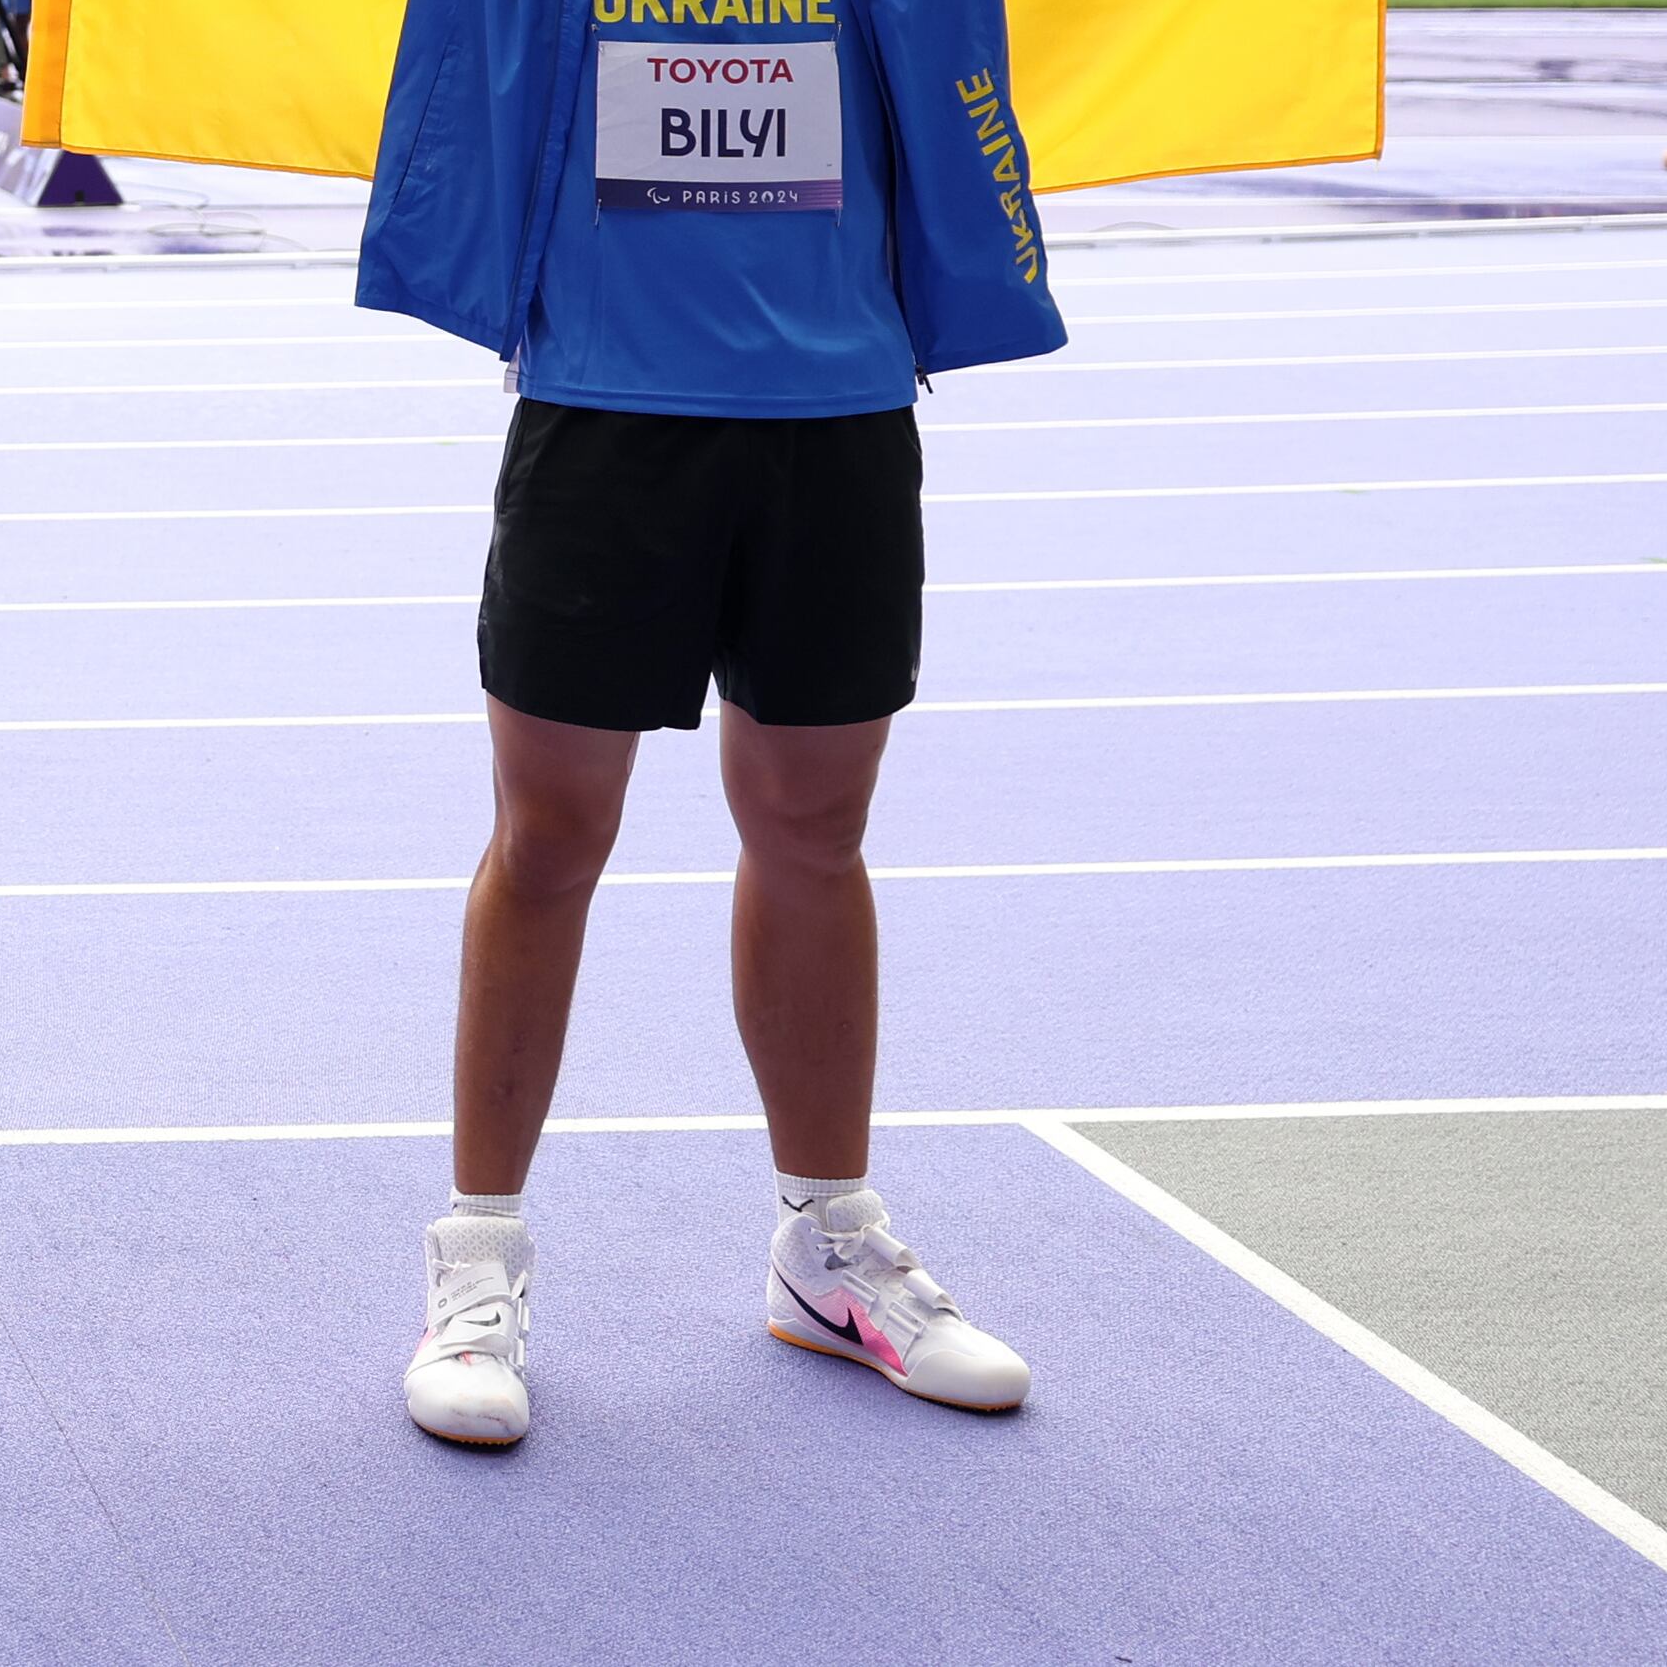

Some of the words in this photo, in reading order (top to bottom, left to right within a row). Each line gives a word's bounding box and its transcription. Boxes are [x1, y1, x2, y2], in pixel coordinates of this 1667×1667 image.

[647, 58, 794, 84] TOYOTA
[661, 108, 786, 157] BILYI
[955, 68, 1038, 284] UKRAINE
[682, 190, 741, 204] PARIS
[749, 190, 798, 204] 2024
